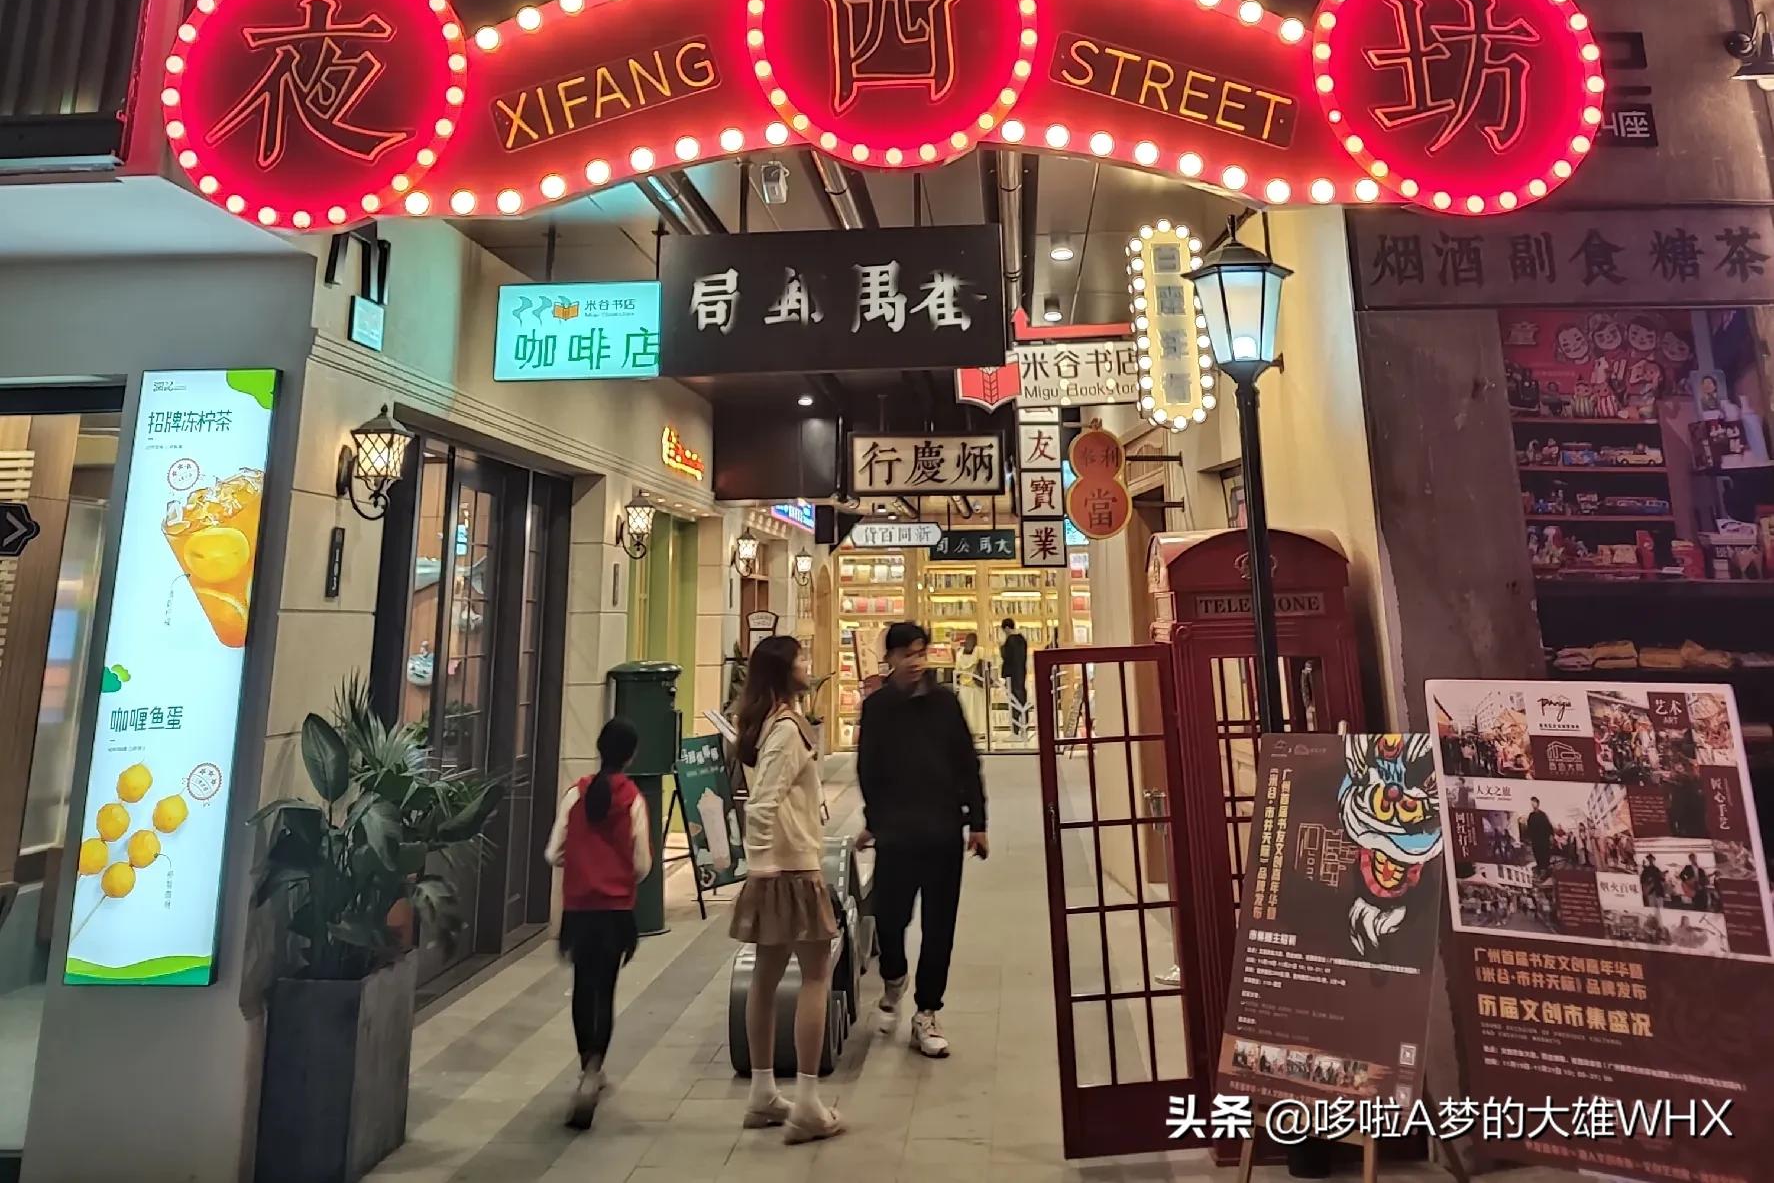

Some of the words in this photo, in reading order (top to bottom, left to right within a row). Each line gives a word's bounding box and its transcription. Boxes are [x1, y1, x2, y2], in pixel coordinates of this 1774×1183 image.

[496, 41, 715, 150] XIFANG
[1060, 39, 1291, 140] STREET
[585, 298, 636, 311] 米谷书店
[514, 326, 660, 370] 咖啡店
[1021, 347, 1137, 380] 米谷书店
[1024, 384, 1059, 401] Migu
[1066, 382, 1136, 399] Bookstor
[147, 409, 232, 434] 招牌冻柠茶
[1199, 595, 1321, 615] TELEONE
[110, 705, 184, 733] 咖喱鱼蛋
[1655, 698, 1684, 716] 艺术
[1477, 993, 1655, 1038] 历届文创市集盛况
